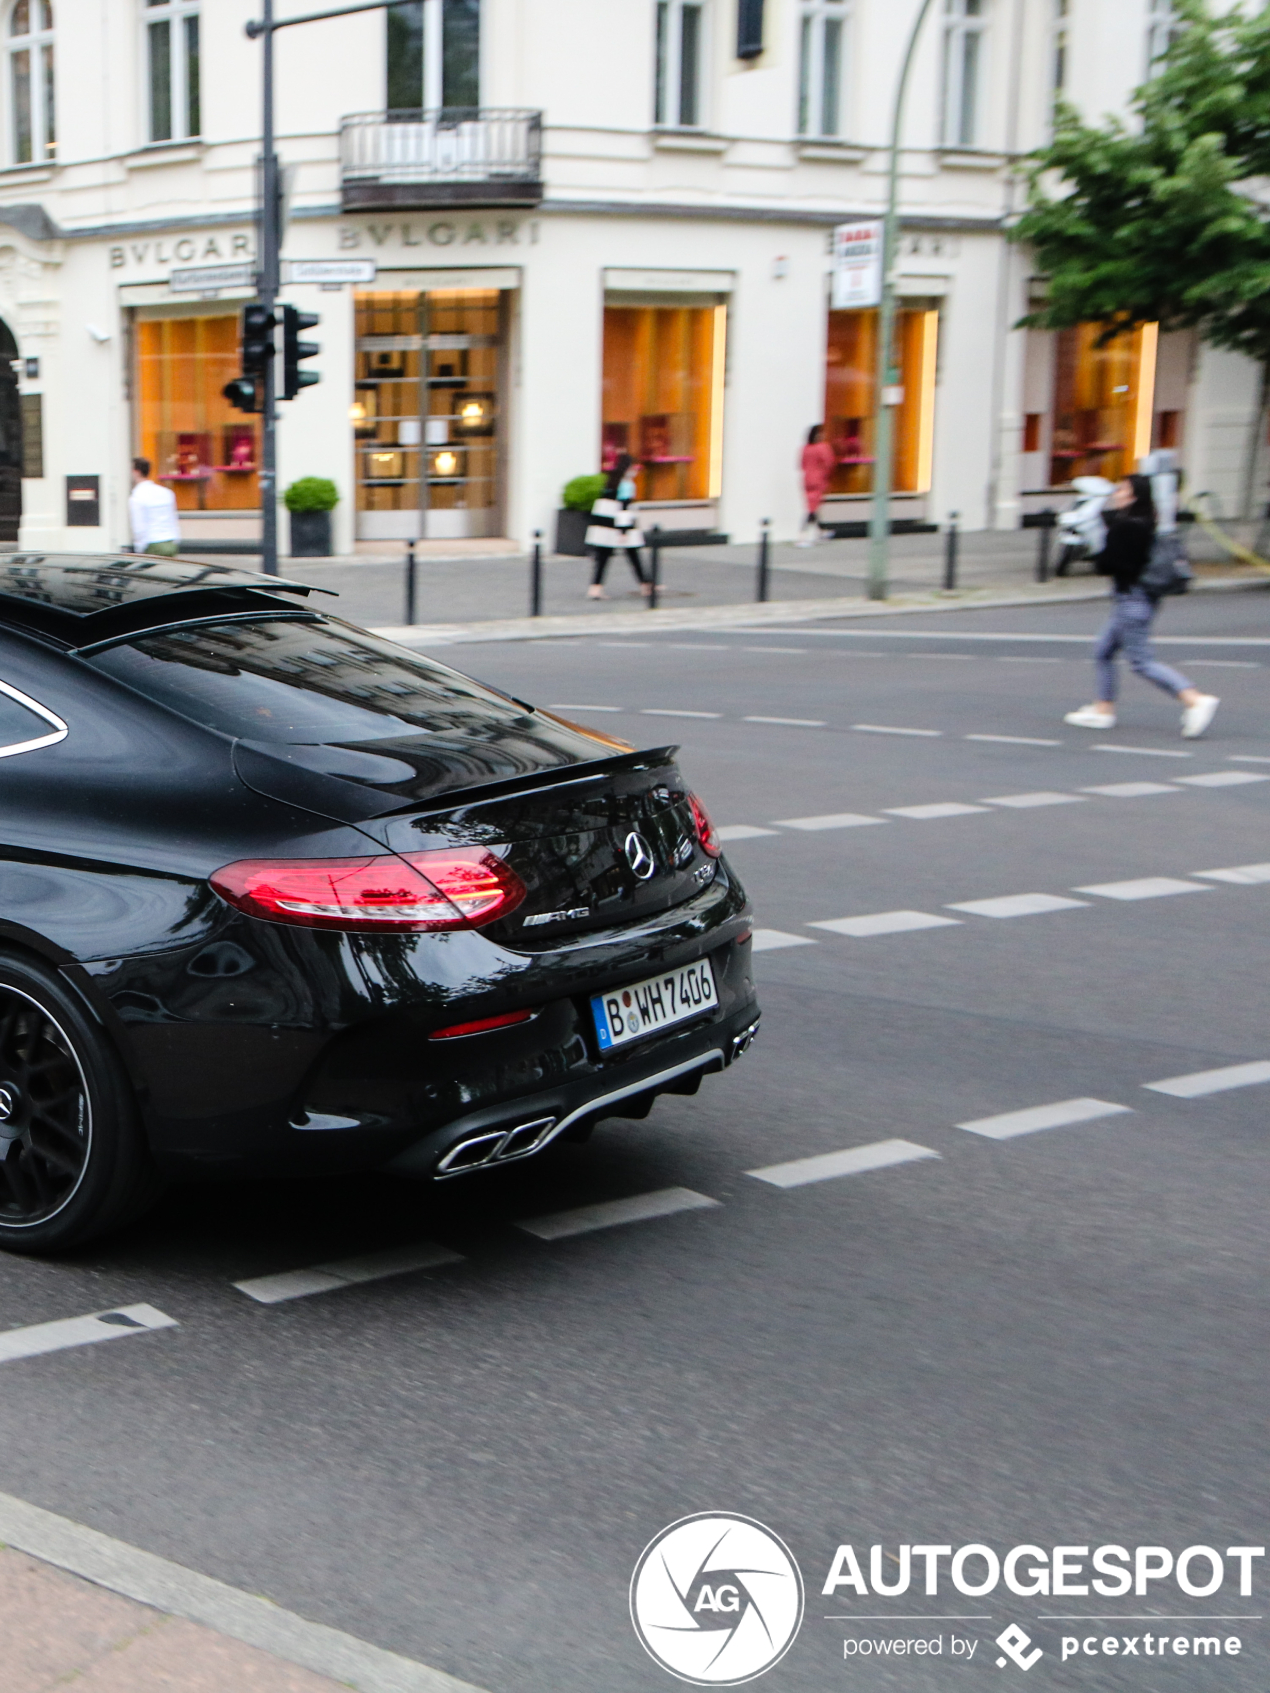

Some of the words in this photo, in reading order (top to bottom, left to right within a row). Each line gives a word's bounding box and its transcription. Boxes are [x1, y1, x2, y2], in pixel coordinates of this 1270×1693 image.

[109, 234, 256, 268] BVLGAR
[338, 219, 541, 250] BVLGARI
[606, 998, 625, 1037] B
